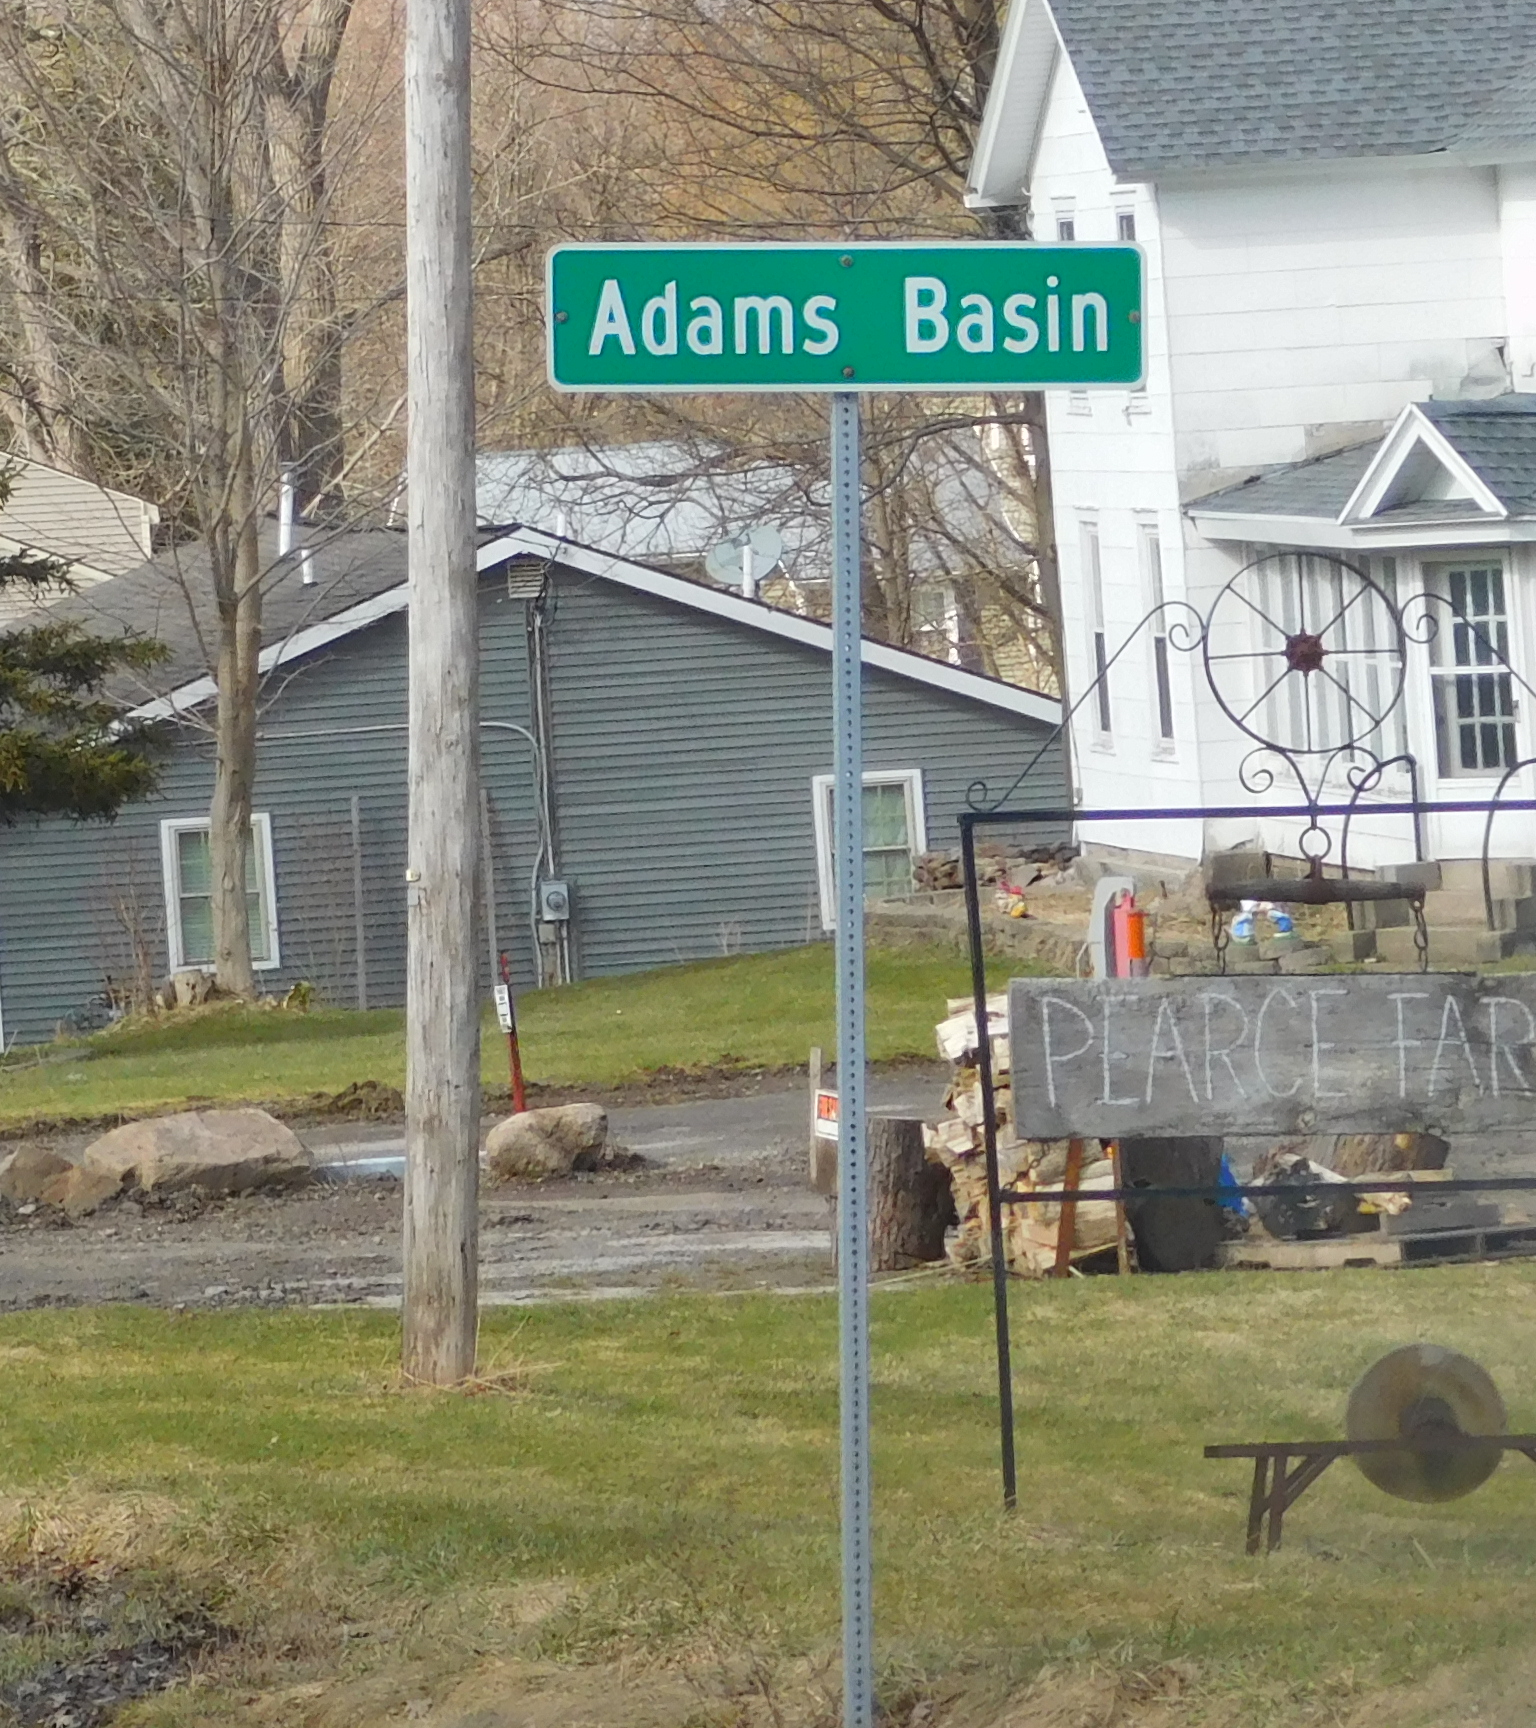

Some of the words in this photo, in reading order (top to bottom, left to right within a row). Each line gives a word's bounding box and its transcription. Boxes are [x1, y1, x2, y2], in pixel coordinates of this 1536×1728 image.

[588, 278, 840, 356] Adams
[904, 275, 1109, 353] Basin
[1041, 986, 1351, 1109] PEARCE
